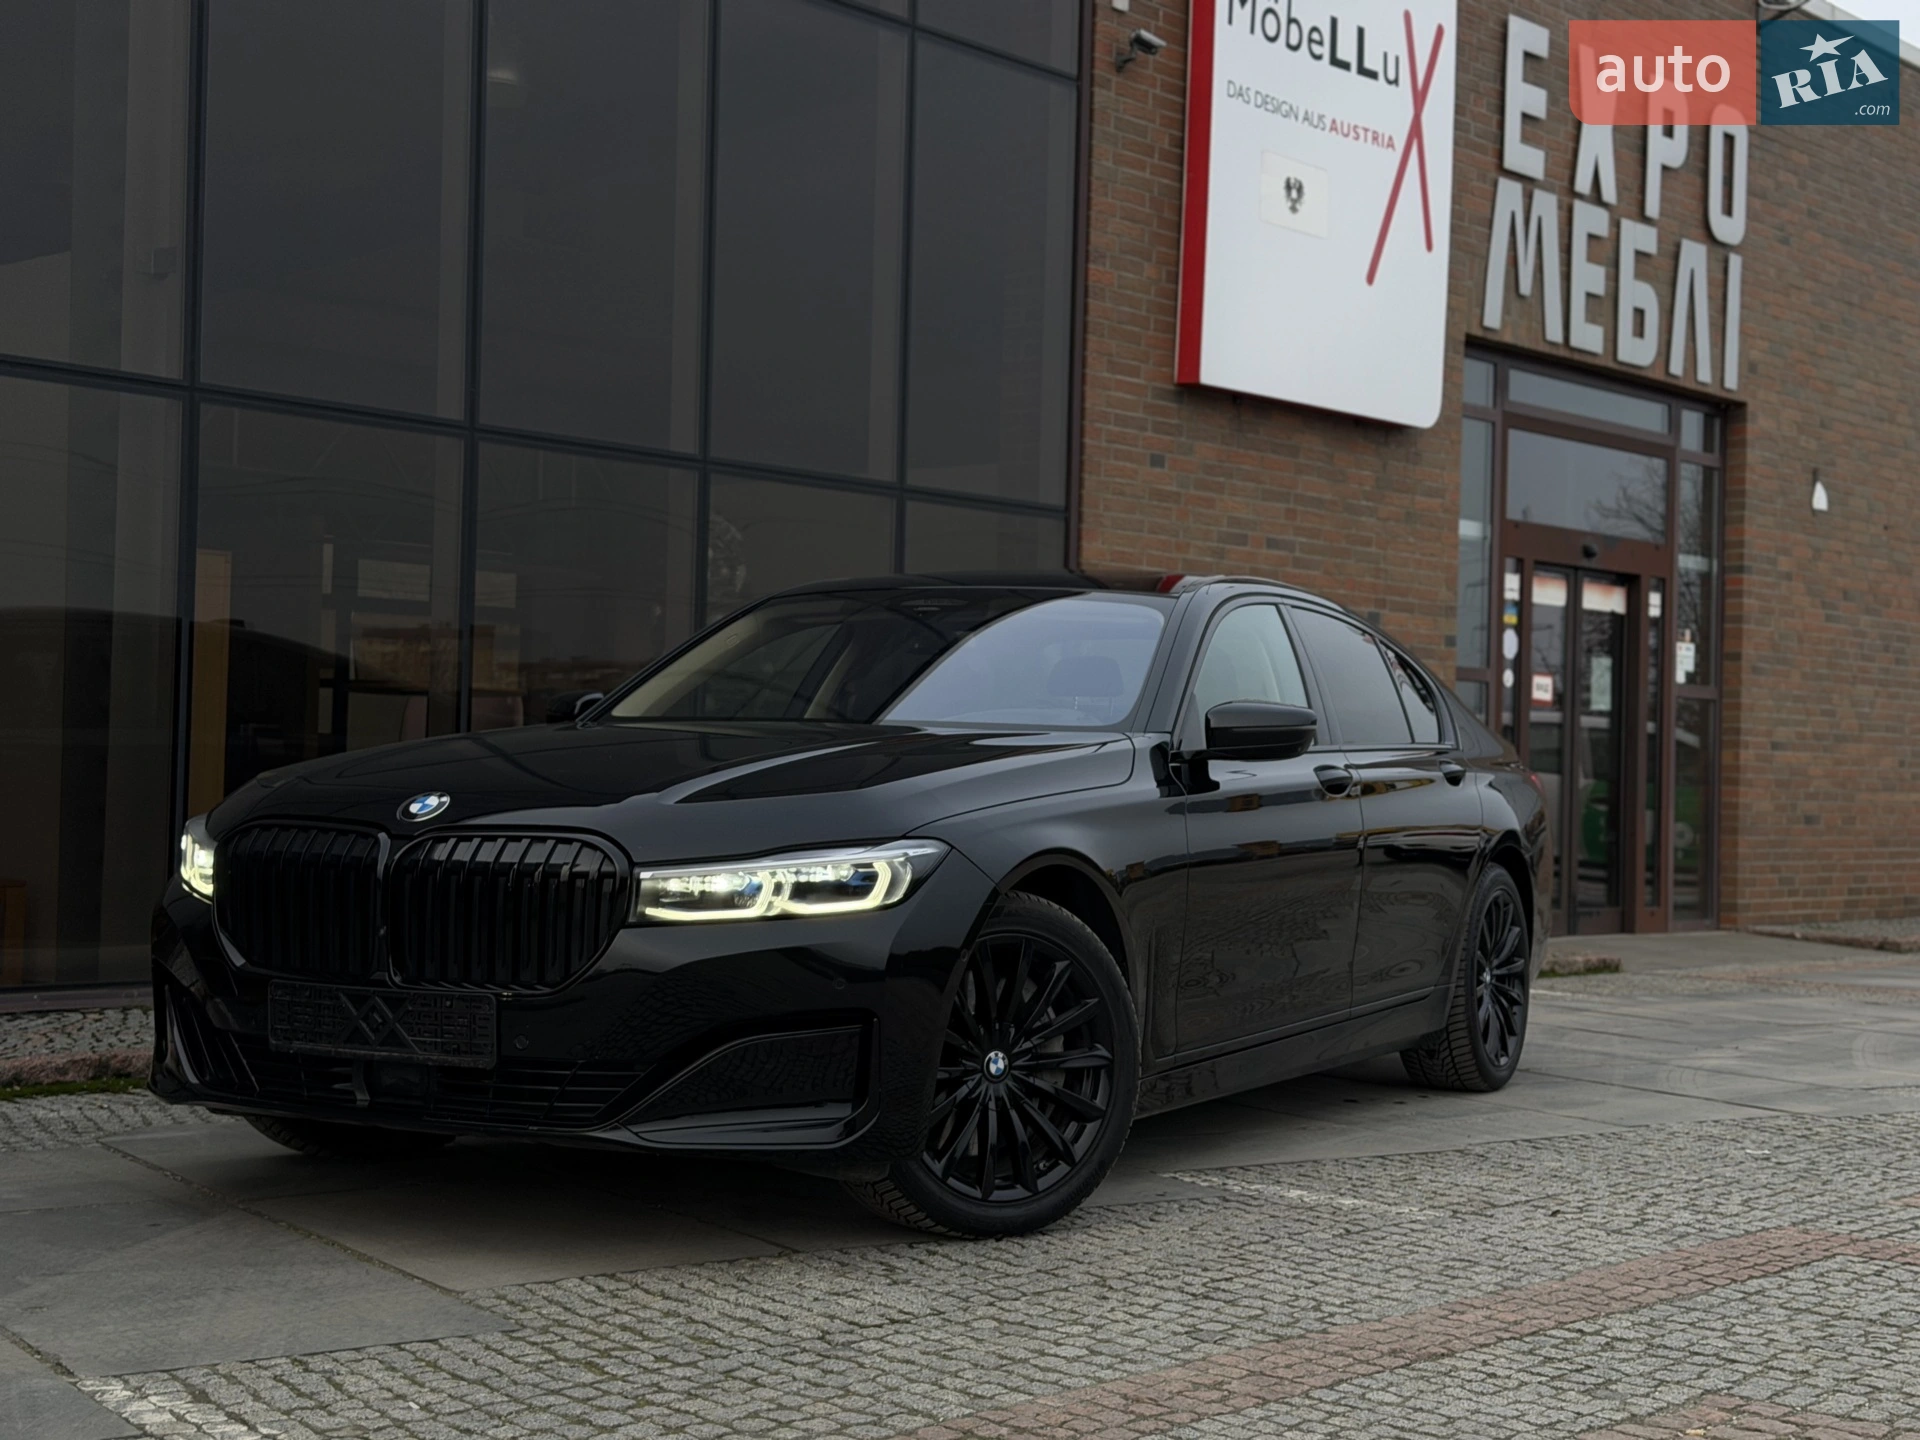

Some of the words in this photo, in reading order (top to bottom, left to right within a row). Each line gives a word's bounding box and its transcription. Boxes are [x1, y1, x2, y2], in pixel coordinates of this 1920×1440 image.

[1227, 80, 1250, 104] DAS
[1254, 91, 1299, 122] DESIGN
[1302, 108, 1326, 131] AUS
[1329, 118, 1396, 151] AUSTRIA
[1482, 176, 1743, 392] МЕБЛІ
